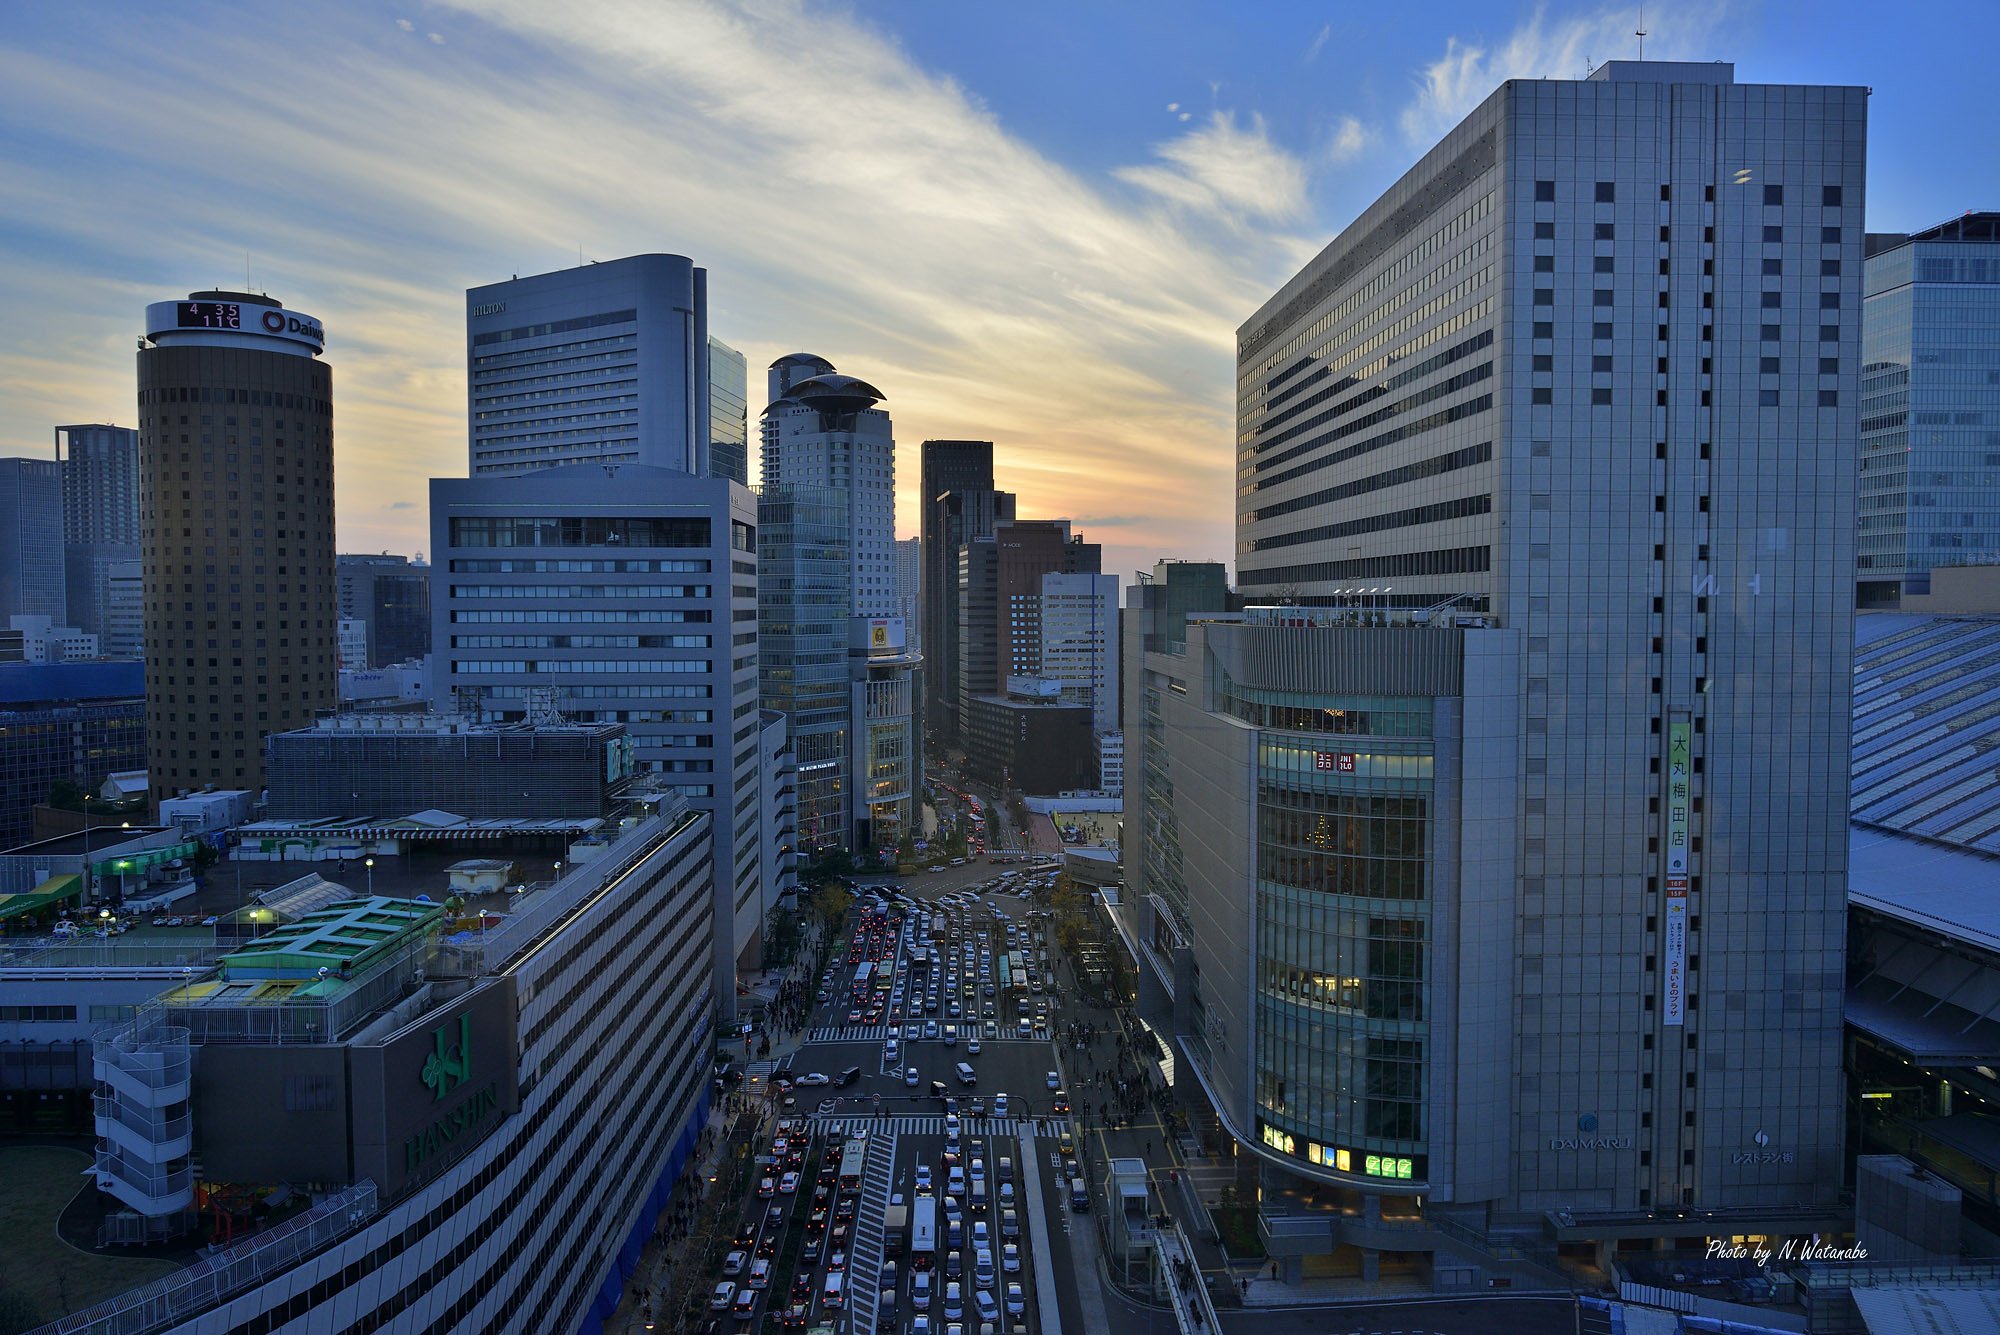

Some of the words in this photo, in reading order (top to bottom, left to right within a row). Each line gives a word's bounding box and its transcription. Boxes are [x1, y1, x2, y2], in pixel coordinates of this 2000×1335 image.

[473, 302, 506, 317] HILTON
[1672, 735, 1686, 846] 大丸梅田店
[1670, 960, 1679, 1017] うまいものプラザ
[405, 1082, 497, 1174] HANSHIN
[1550, 1137, 1631, 1150] DAIMARU
[1731, 1152, 1793, 1165] レストラン街
